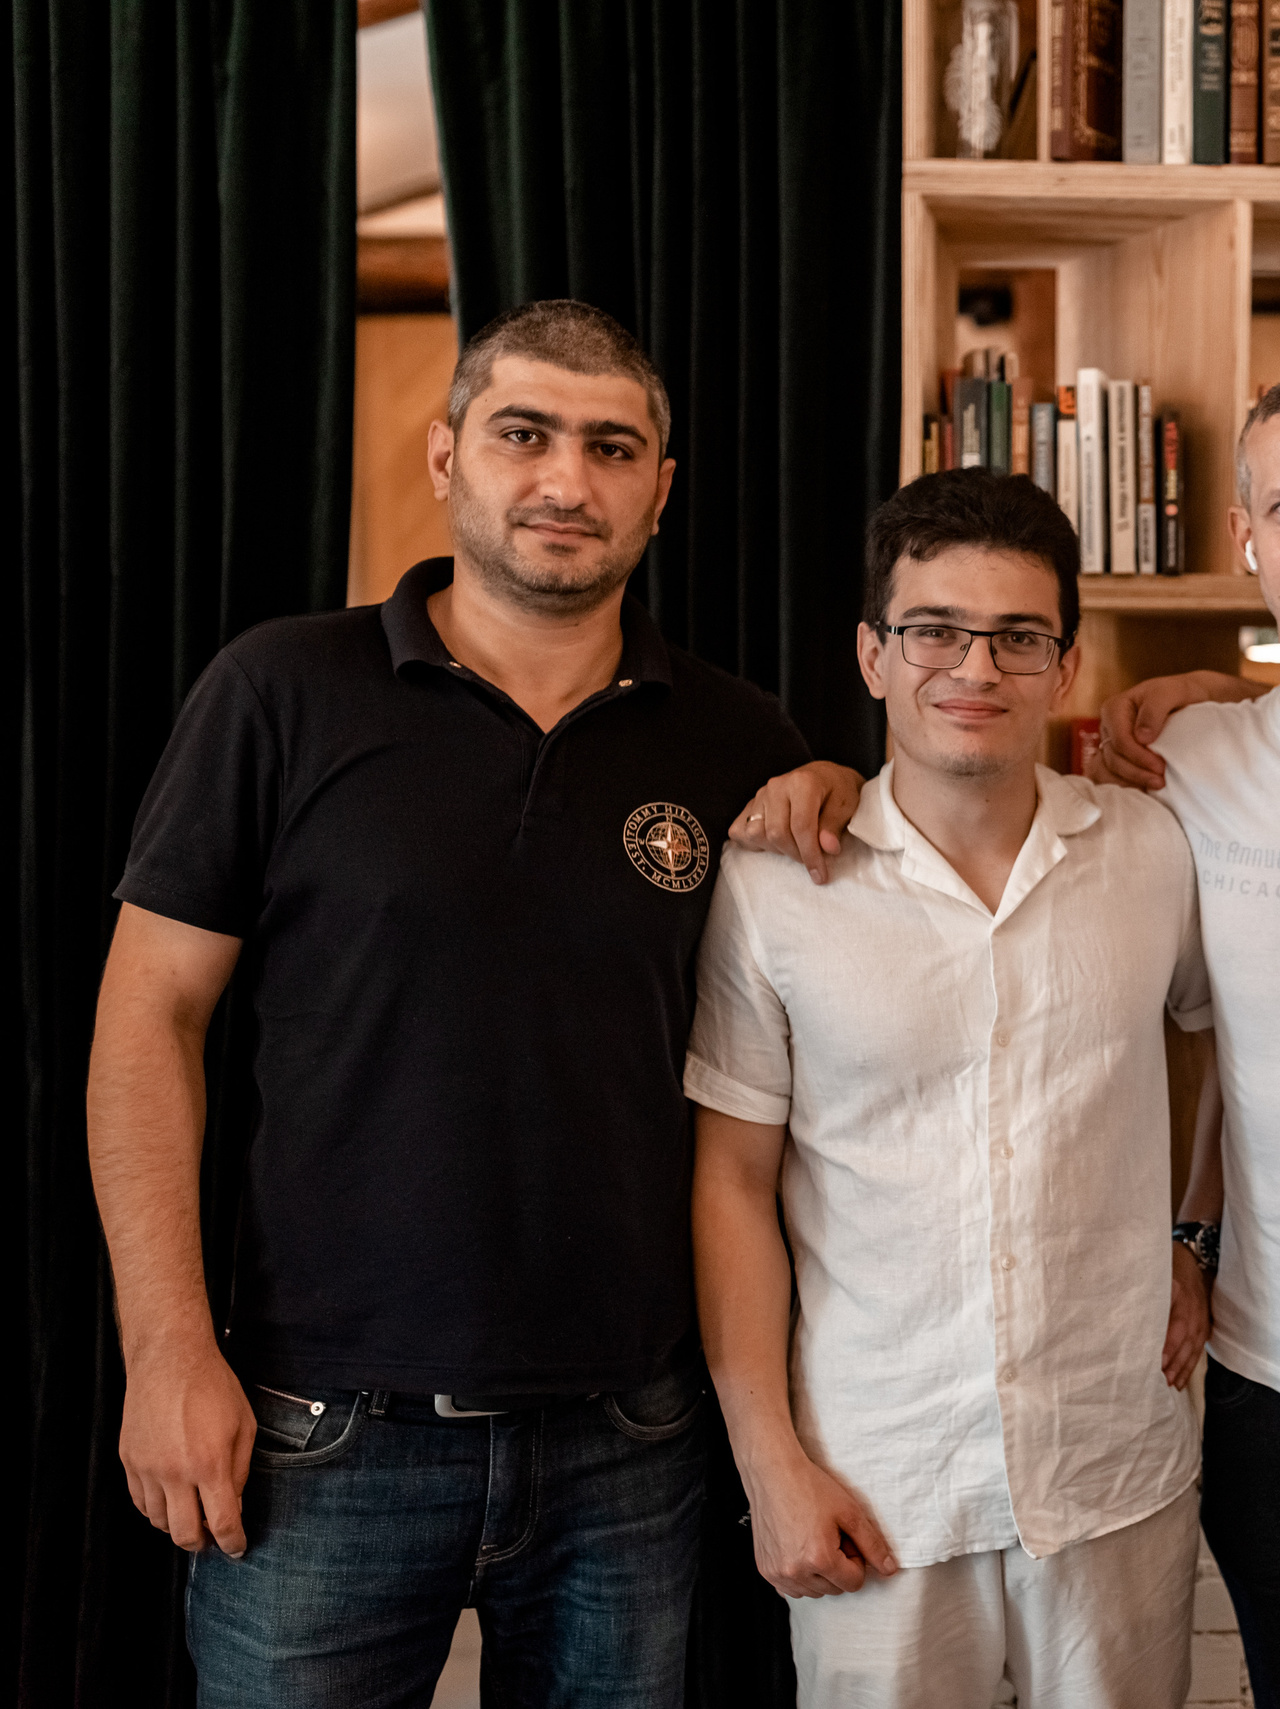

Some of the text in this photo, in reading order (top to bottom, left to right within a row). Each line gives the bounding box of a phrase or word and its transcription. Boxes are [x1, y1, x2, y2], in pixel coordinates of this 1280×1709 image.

[626, 804, 707, 852] TOMMY HILFIGER
[1198, 832, 1220, 859] The
